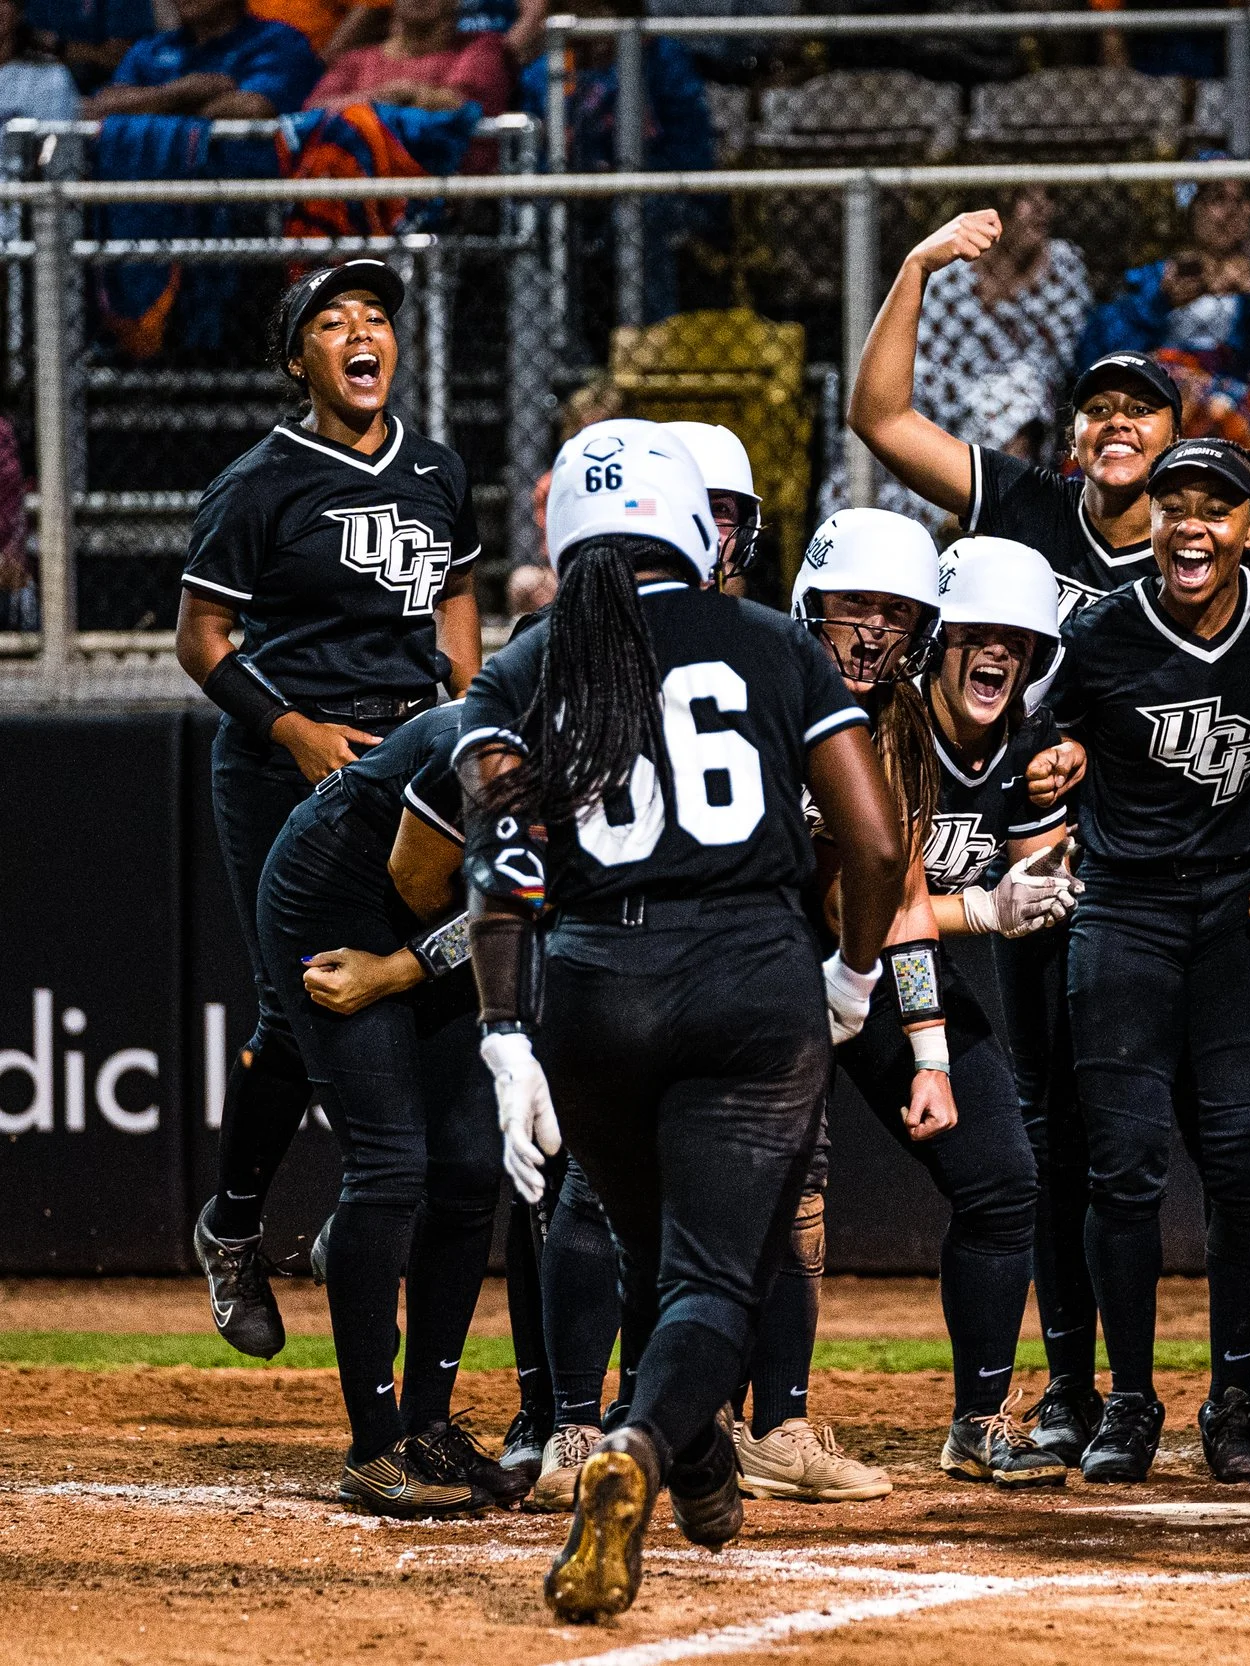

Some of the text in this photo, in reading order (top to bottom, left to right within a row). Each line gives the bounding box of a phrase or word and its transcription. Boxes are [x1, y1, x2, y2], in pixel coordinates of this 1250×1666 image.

[585, 463, 623, 493] 66
[321, 502, 452, 616] UCF
[912, 812, 1007, 896] UC
